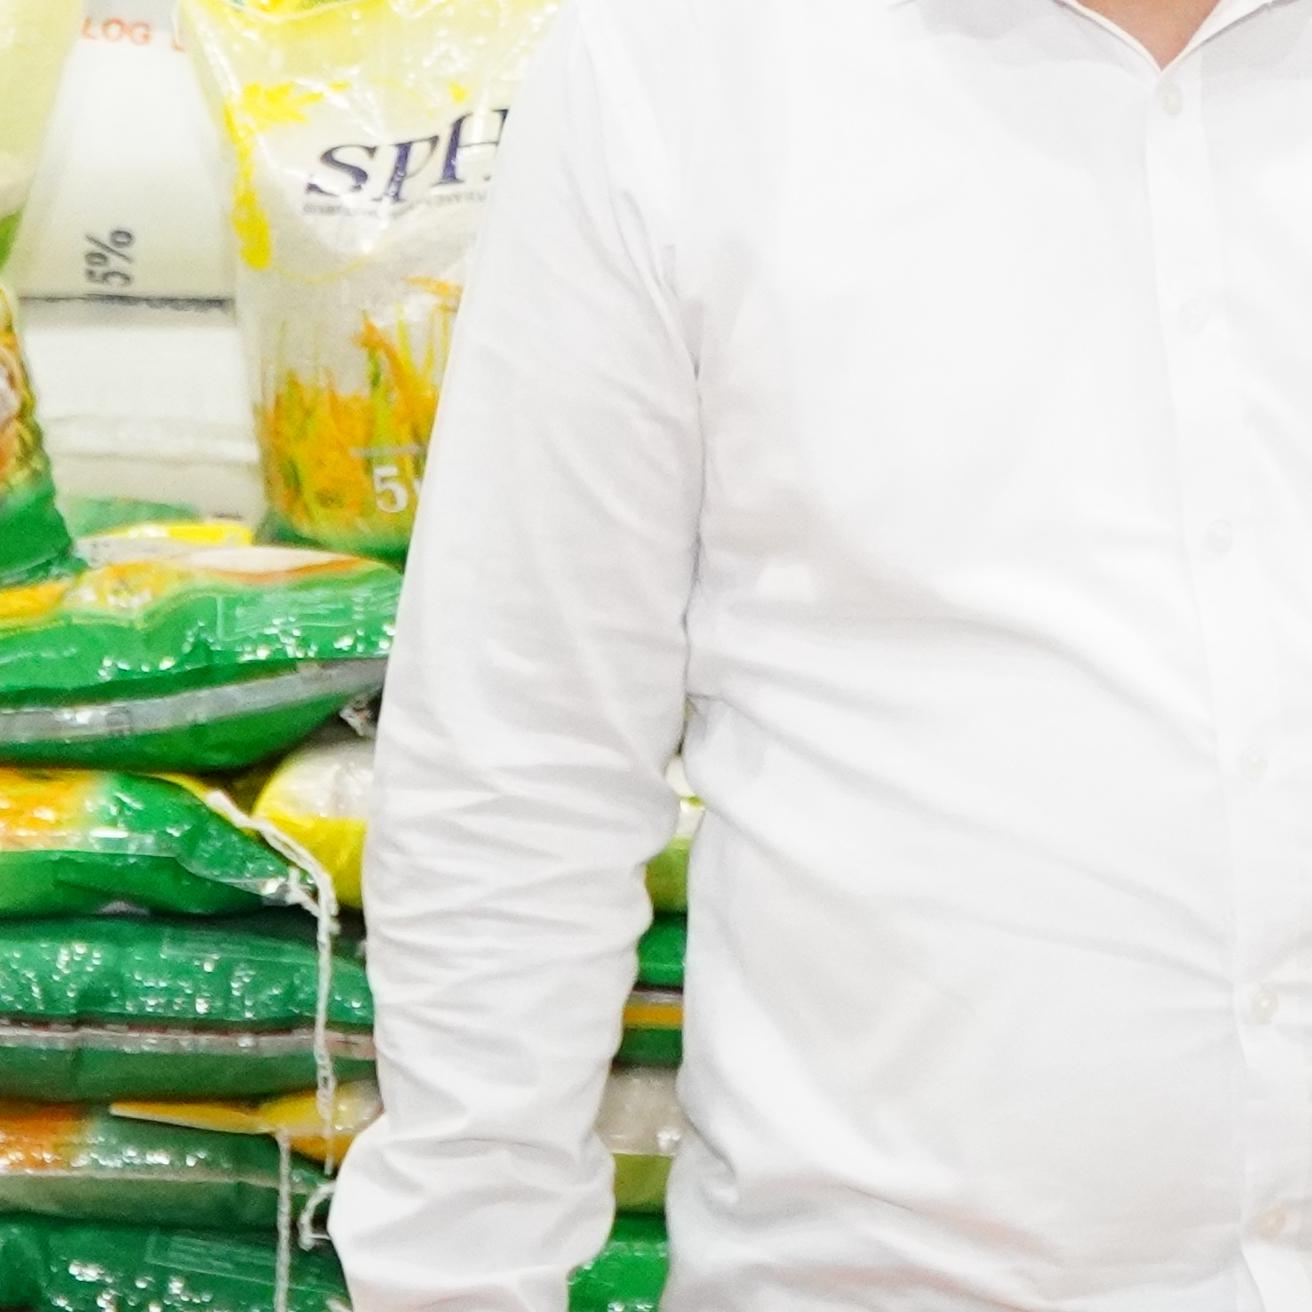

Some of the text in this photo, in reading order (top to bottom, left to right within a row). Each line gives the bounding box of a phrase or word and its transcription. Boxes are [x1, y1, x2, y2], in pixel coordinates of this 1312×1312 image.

[303, 107, 512, 205] SPH
[83, 228, 136, 288] 5%
[373, 464, 408, 513] 5
